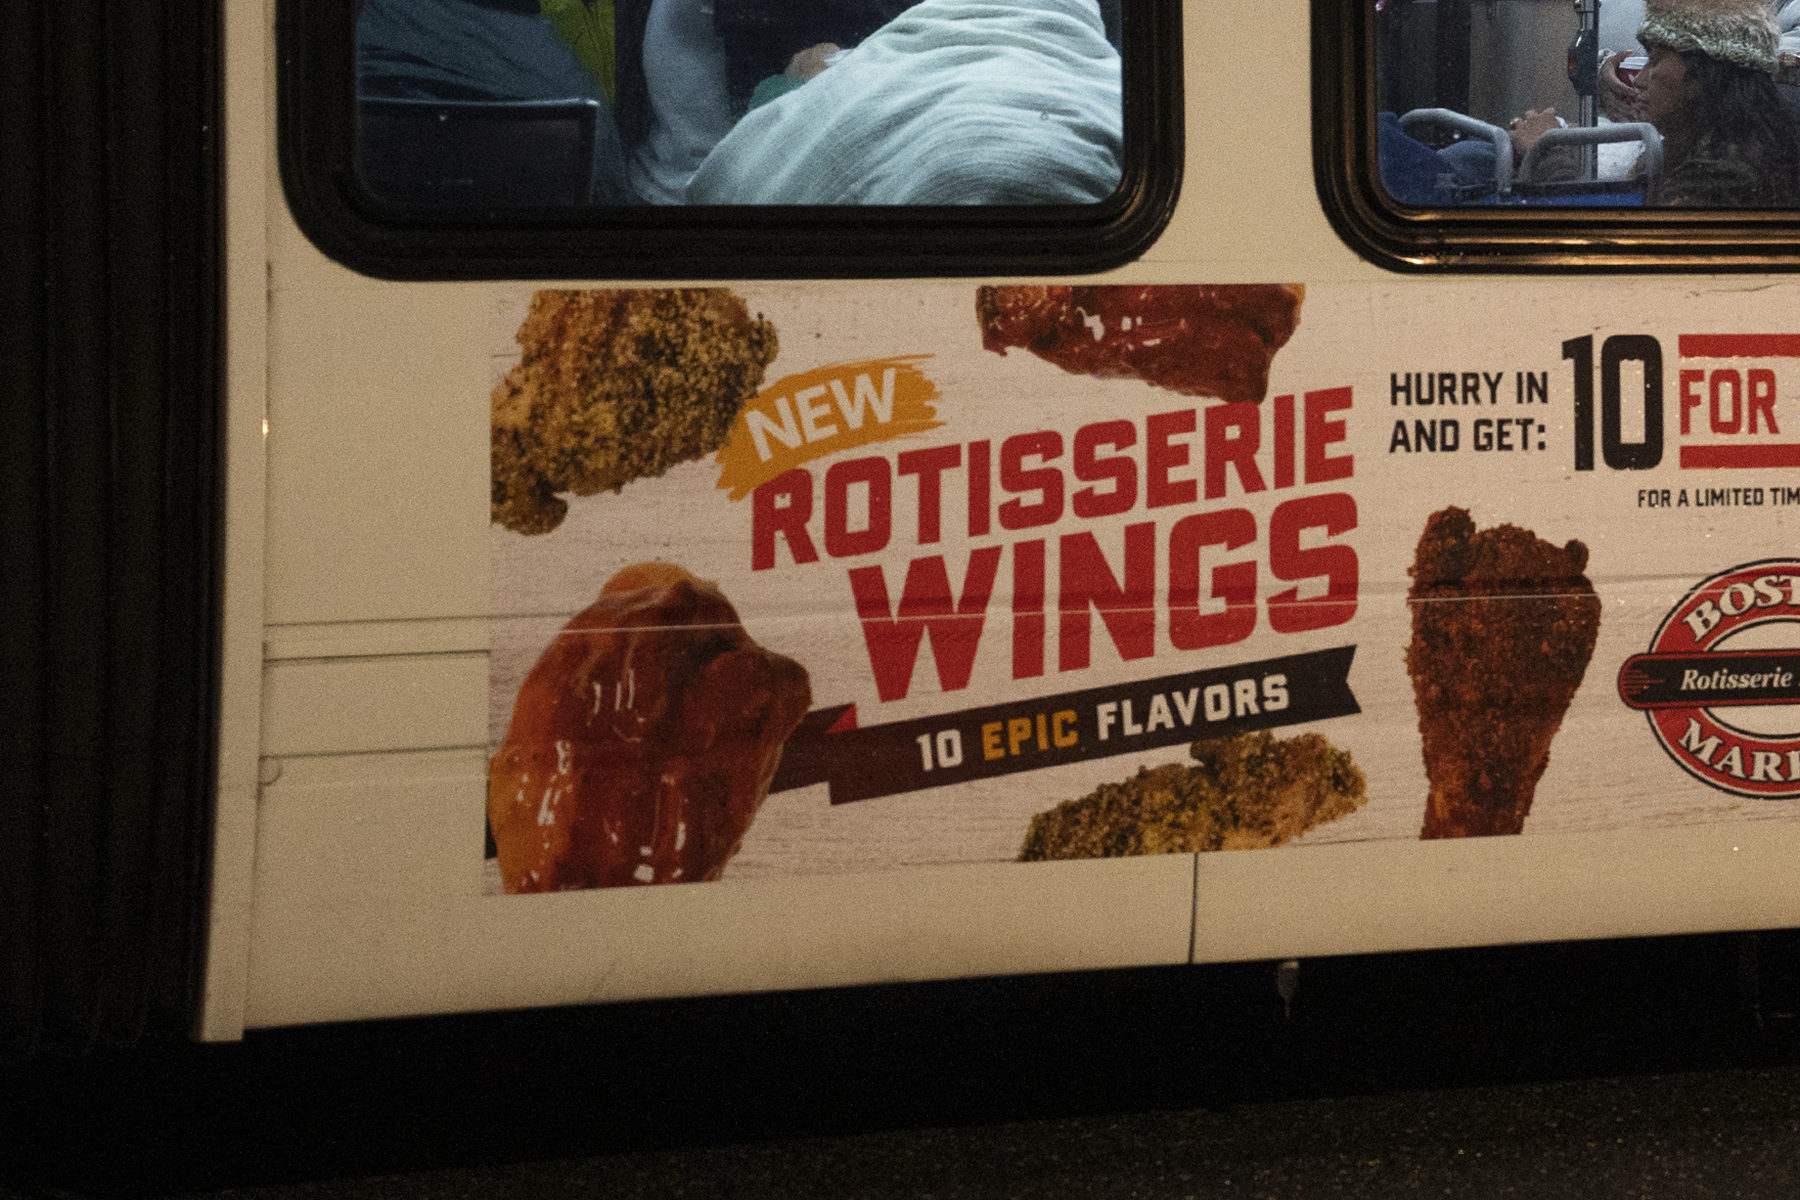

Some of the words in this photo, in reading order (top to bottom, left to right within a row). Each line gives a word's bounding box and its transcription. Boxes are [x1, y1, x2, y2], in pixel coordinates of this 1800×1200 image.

[746, 369, 897, 463] NEW
[1389, 418, 1460, 454] AND
[1473, 418, 1547, 452] GET:
[1390, 372, 1505, 406] HURRY
[1516, 372, 1548, 403] IN
[1562, 333, 1664, 471] 10
[1679, 367, 1780, 436] FOR
[751, 385, 1355, 571] ROTISSERIE
[1637, 489, 1671, 508] FOR
[1677, 489, 1689, 507] A
[1695, 488, 1764, 507] LIMITED
[848, 491, 1359, 704] WINGS
[916, 728, 963, 772] 10
[983, 709, 1079, 763] EPIC
[1097, 672, 1289, 742] FLAVORS
[1680, 666, 1793, 693] Rotisserie
